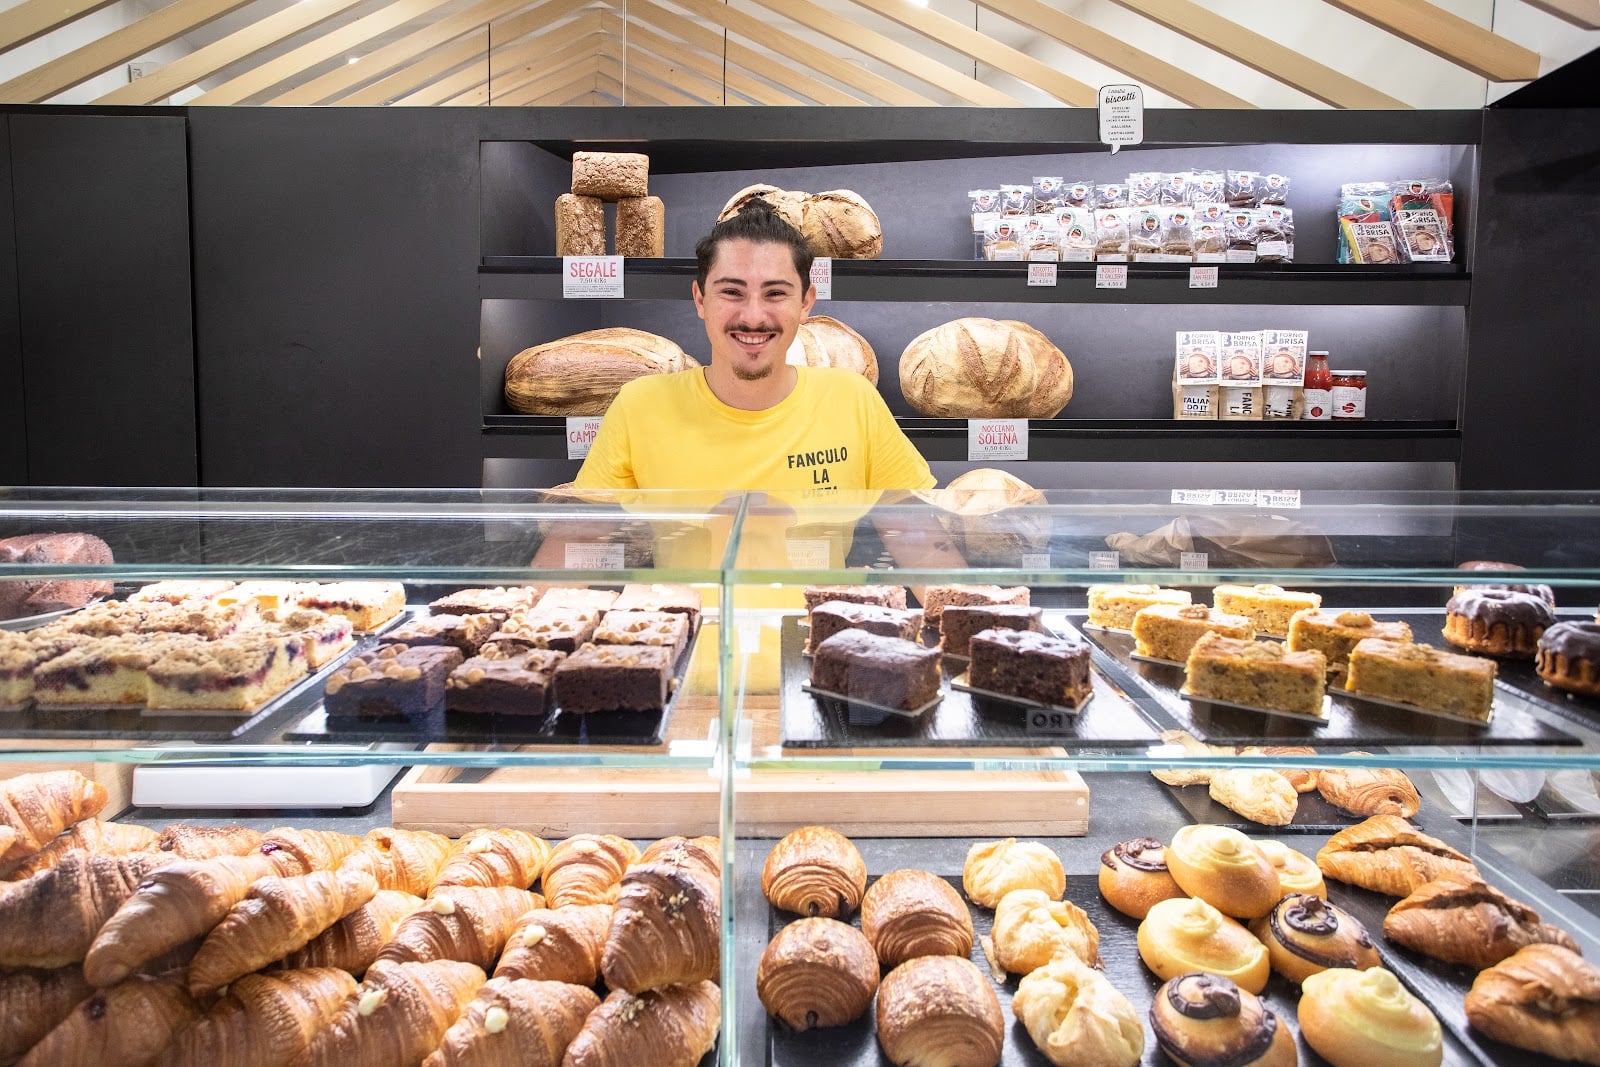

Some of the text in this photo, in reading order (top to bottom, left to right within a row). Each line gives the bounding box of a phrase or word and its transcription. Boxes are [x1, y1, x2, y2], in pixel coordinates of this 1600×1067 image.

[1105, 92, 1136, 103] biscotti
[570, 261, 616, 278] SEGALE
[1233, 340, 1258, 348] BRISA
[981, 424, 1015, 433] NOCCIANO
[978, 432, 1018, 445] SOLINA
[787, 446, 848, 469] FANCULO
[813, 468, 830, 485] LA
